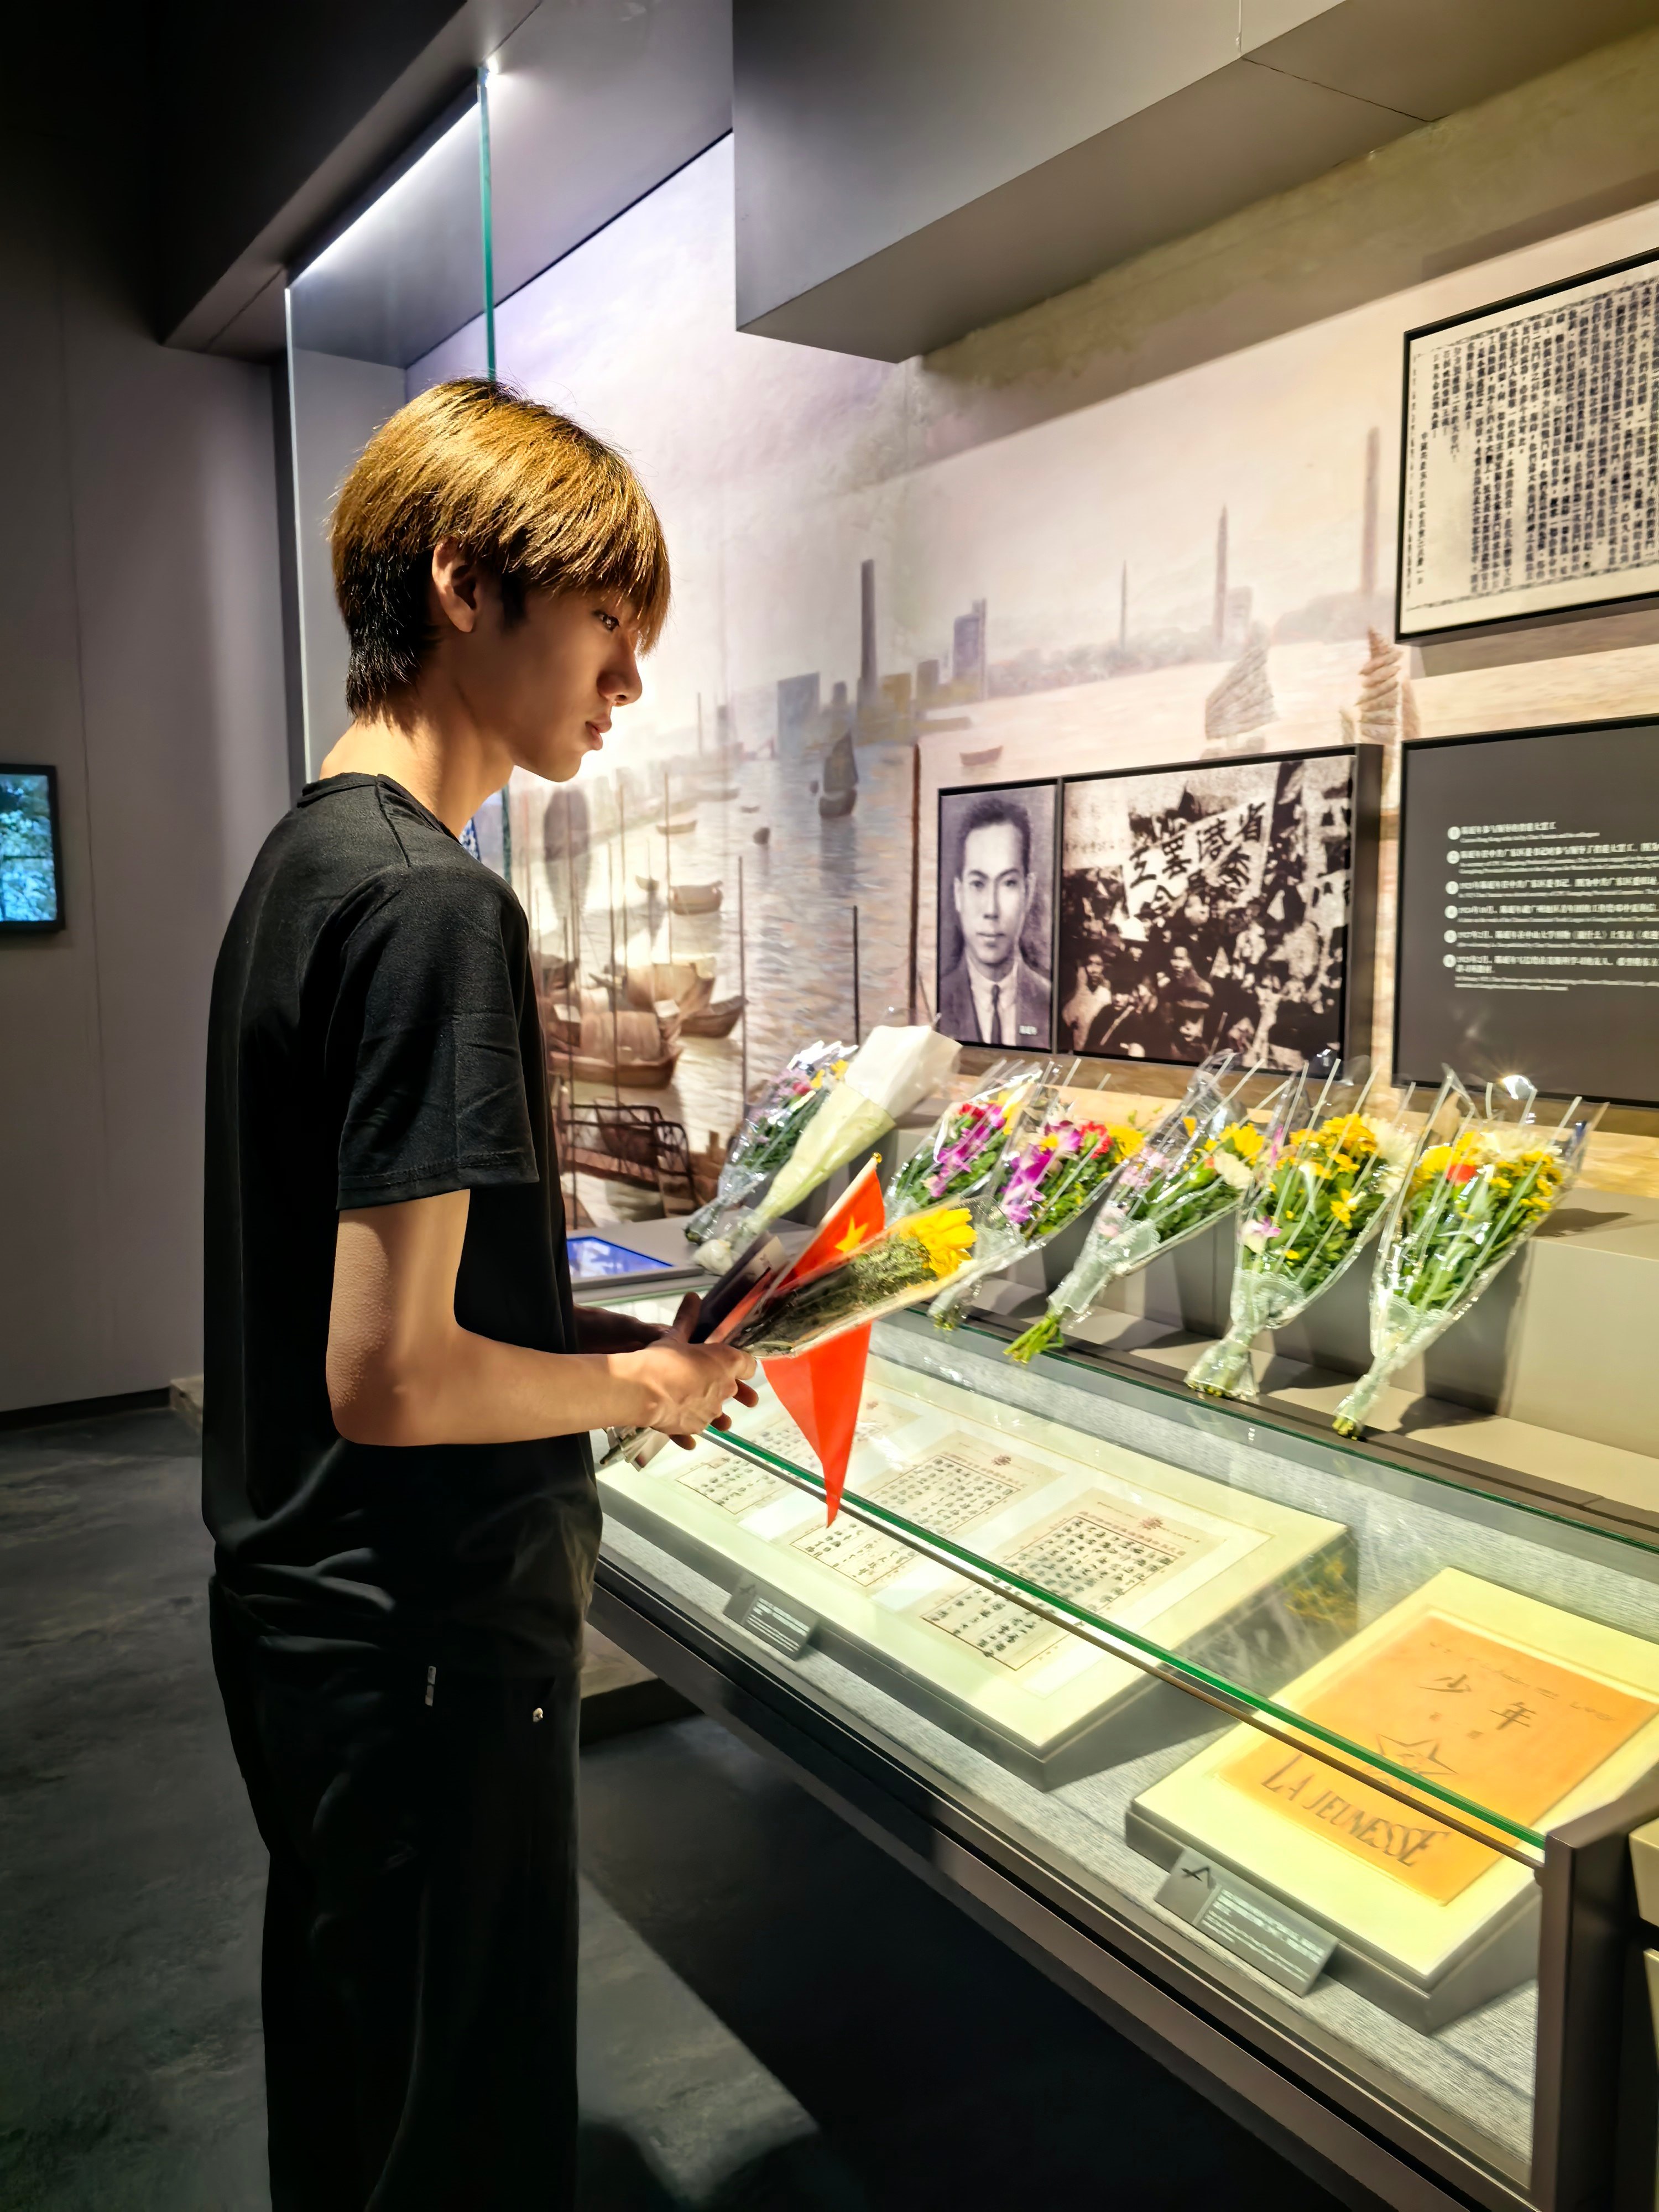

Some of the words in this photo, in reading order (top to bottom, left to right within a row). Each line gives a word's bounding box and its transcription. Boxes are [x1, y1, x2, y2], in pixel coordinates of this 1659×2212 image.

[1418, 1673, 1538, 1730] 少年
[1261, 1752, 1315, 1801] LA
[1302, 1787, 1451, 1867] JEUNESSE
